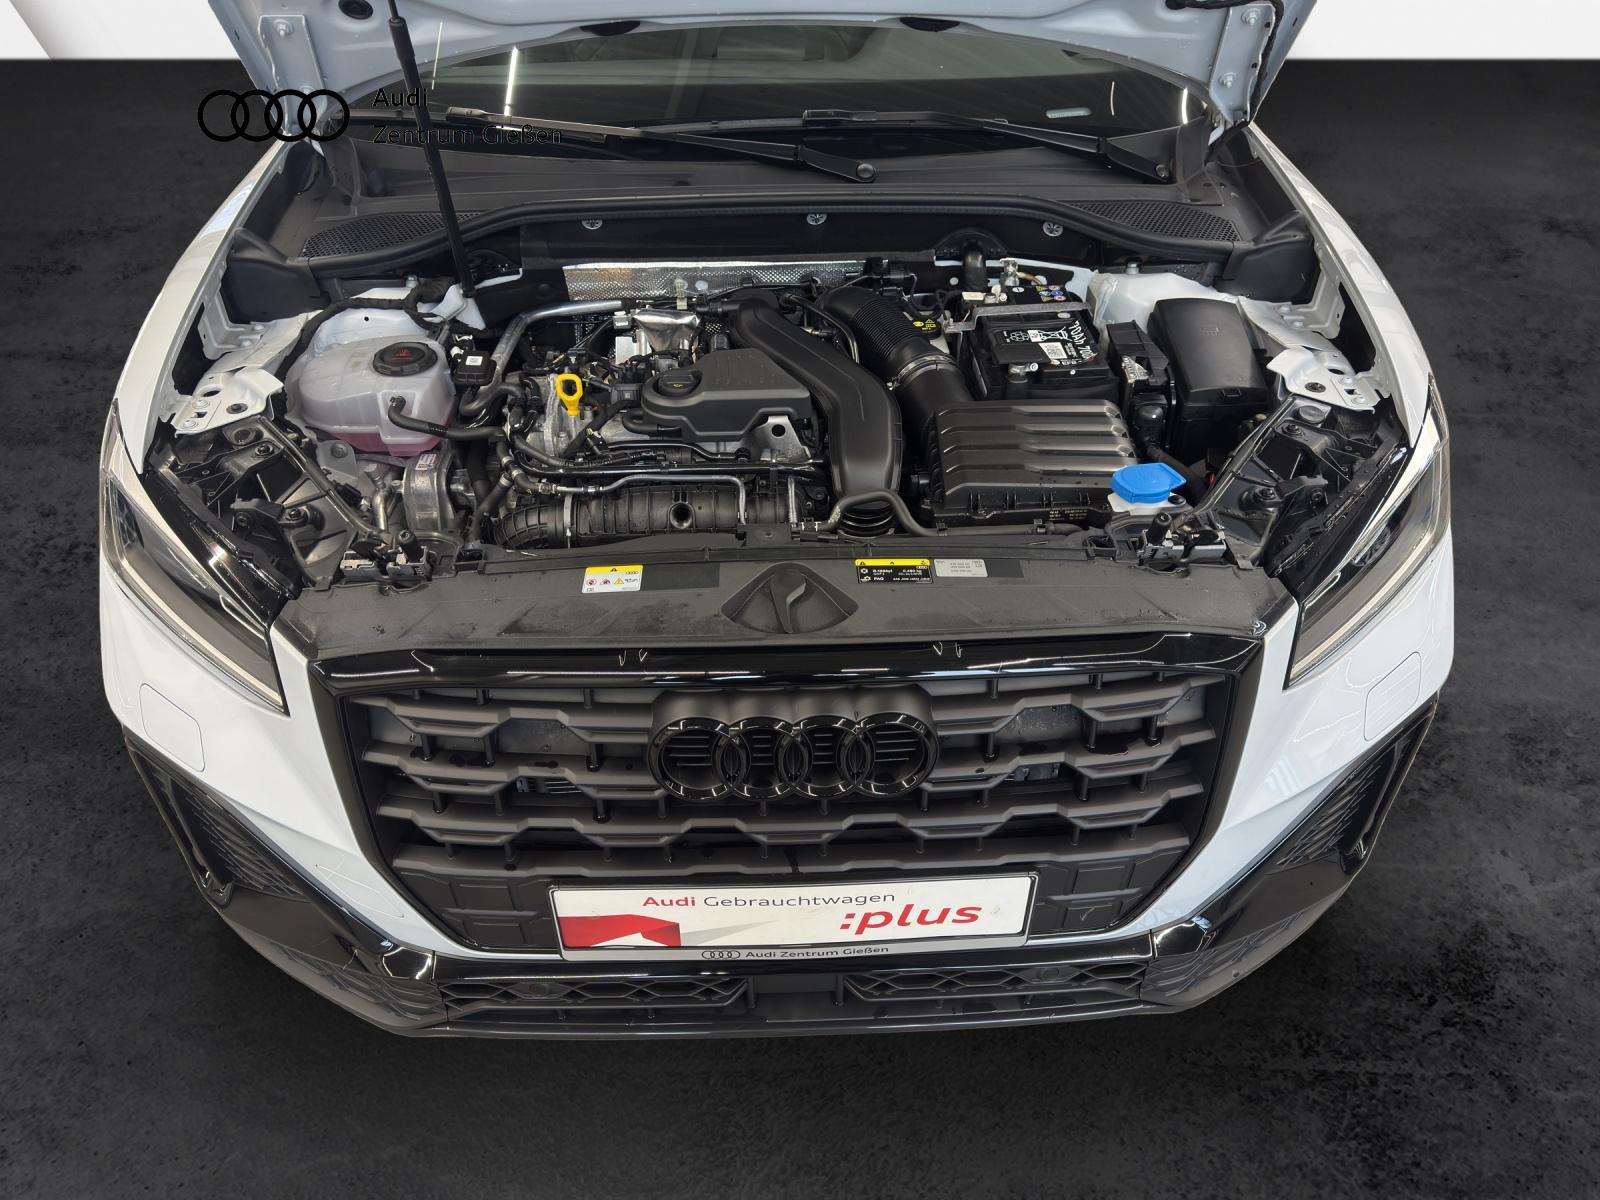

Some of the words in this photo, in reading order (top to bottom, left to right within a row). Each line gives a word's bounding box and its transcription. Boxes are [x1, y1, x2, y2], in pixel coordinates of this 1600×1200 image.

[643, 896, 696, 907] Audi
[704, 893, 895, 907] Gebrauchtwagen
[839, 903, 982, 935] :plus
[745, 951, 776, 959] Audi
[780, 950, 839, 958] Zentrum
[843, 946, 889, 956] Gießen
